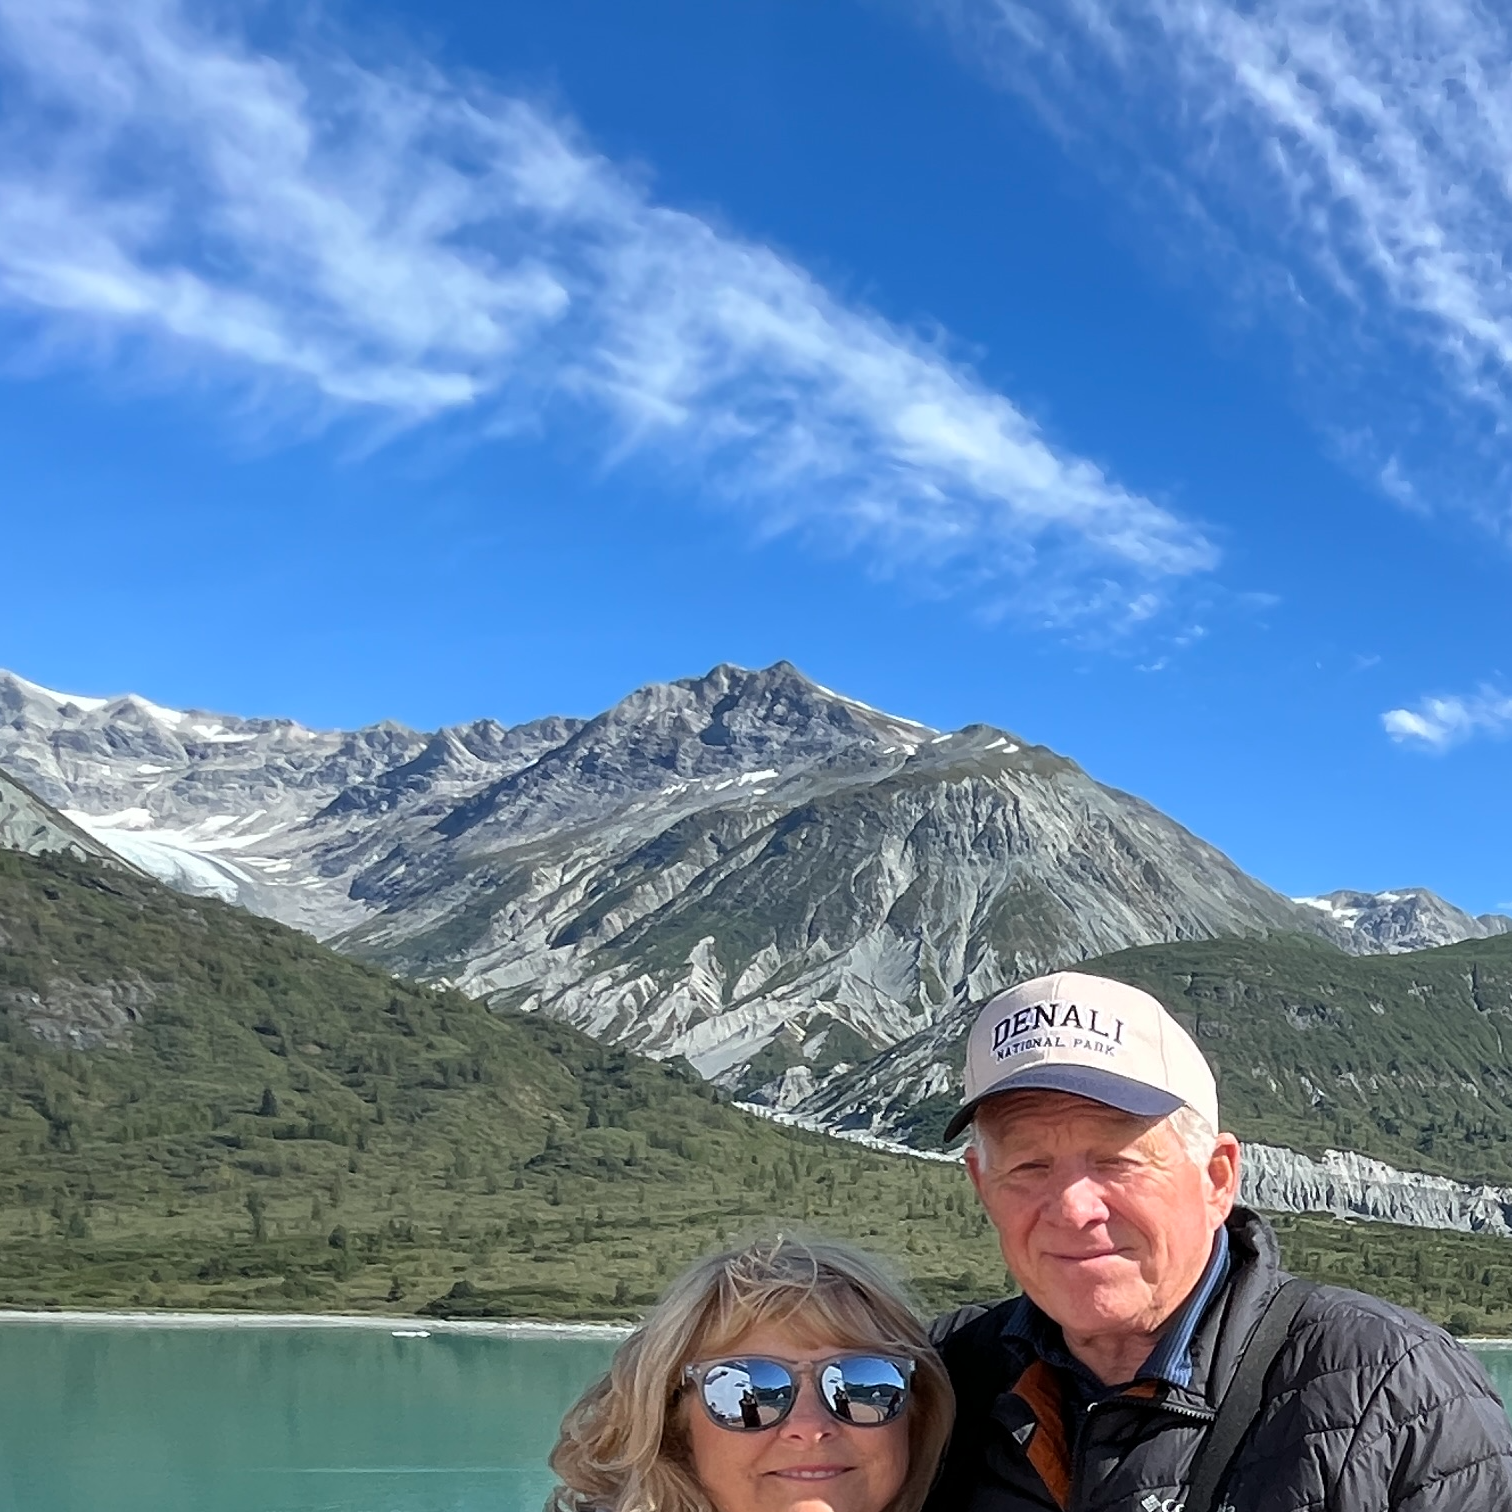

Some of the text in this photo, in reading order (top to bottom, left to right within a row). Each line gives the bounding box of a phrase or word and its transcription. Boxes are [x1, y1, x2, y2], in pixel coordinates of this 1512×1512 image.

[992, 1003, 1124, 1051] DENALI
[996, 1036, 1116, 1062] NATIONAL PARK
